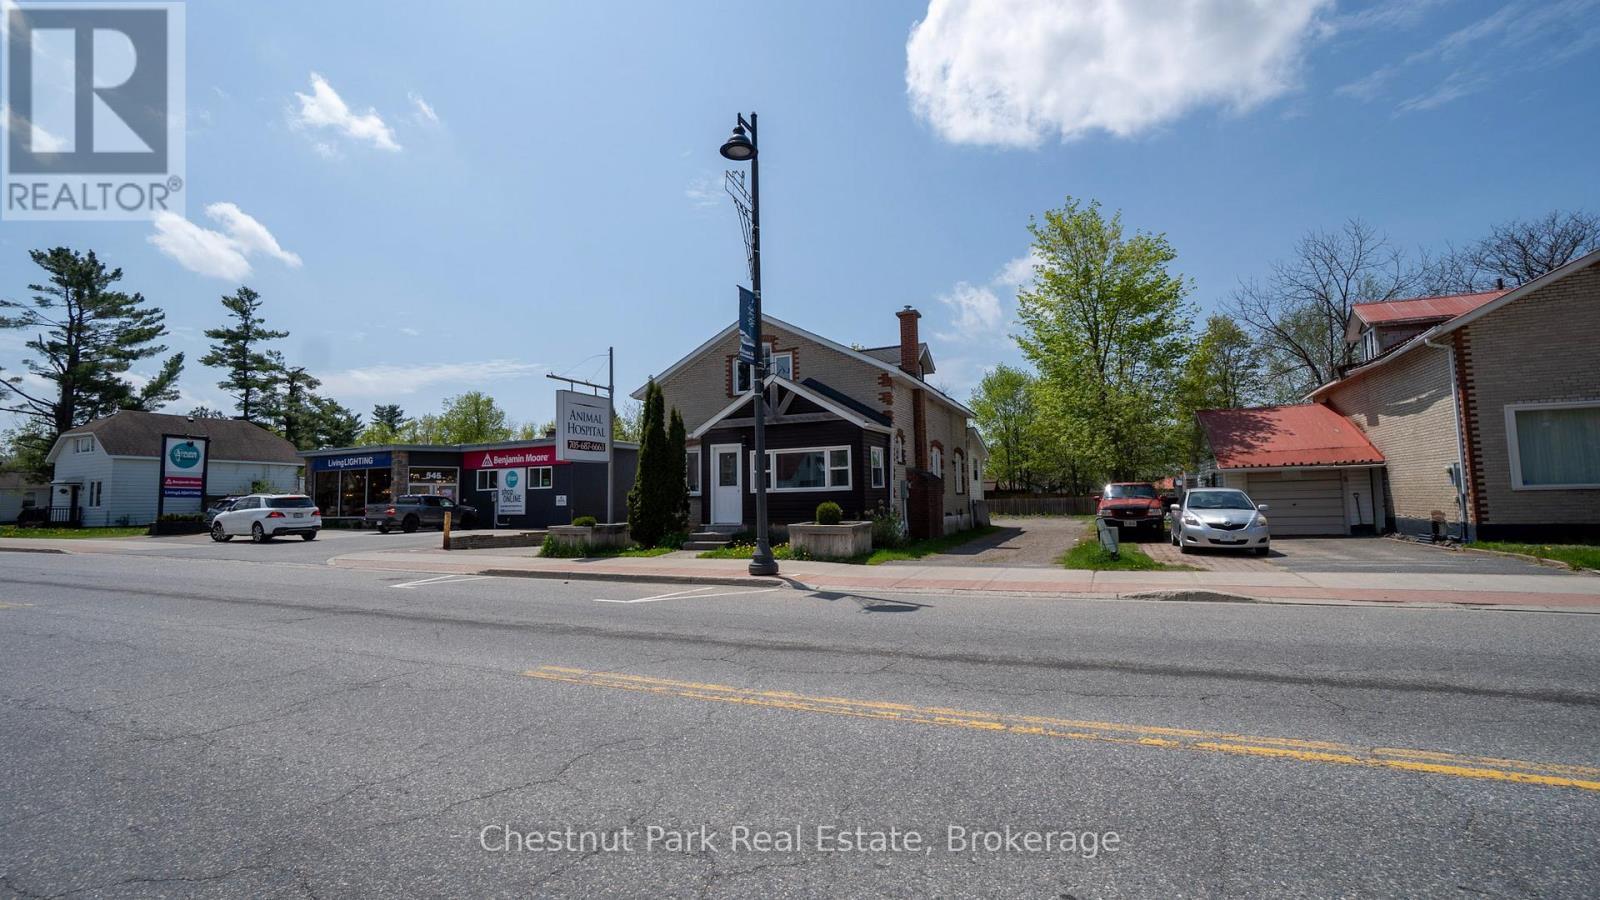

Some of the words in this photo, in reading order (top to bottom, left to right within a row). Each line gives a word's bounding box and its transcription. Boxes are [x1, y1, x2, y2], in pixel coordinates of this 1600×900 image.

[569, 410, 603, 424] ANIMAL
[567, 422, 606, 437] HOSPITAL
[493, 454, 525, 465] Benjamin
[525, 453, 548, 462] Moore
